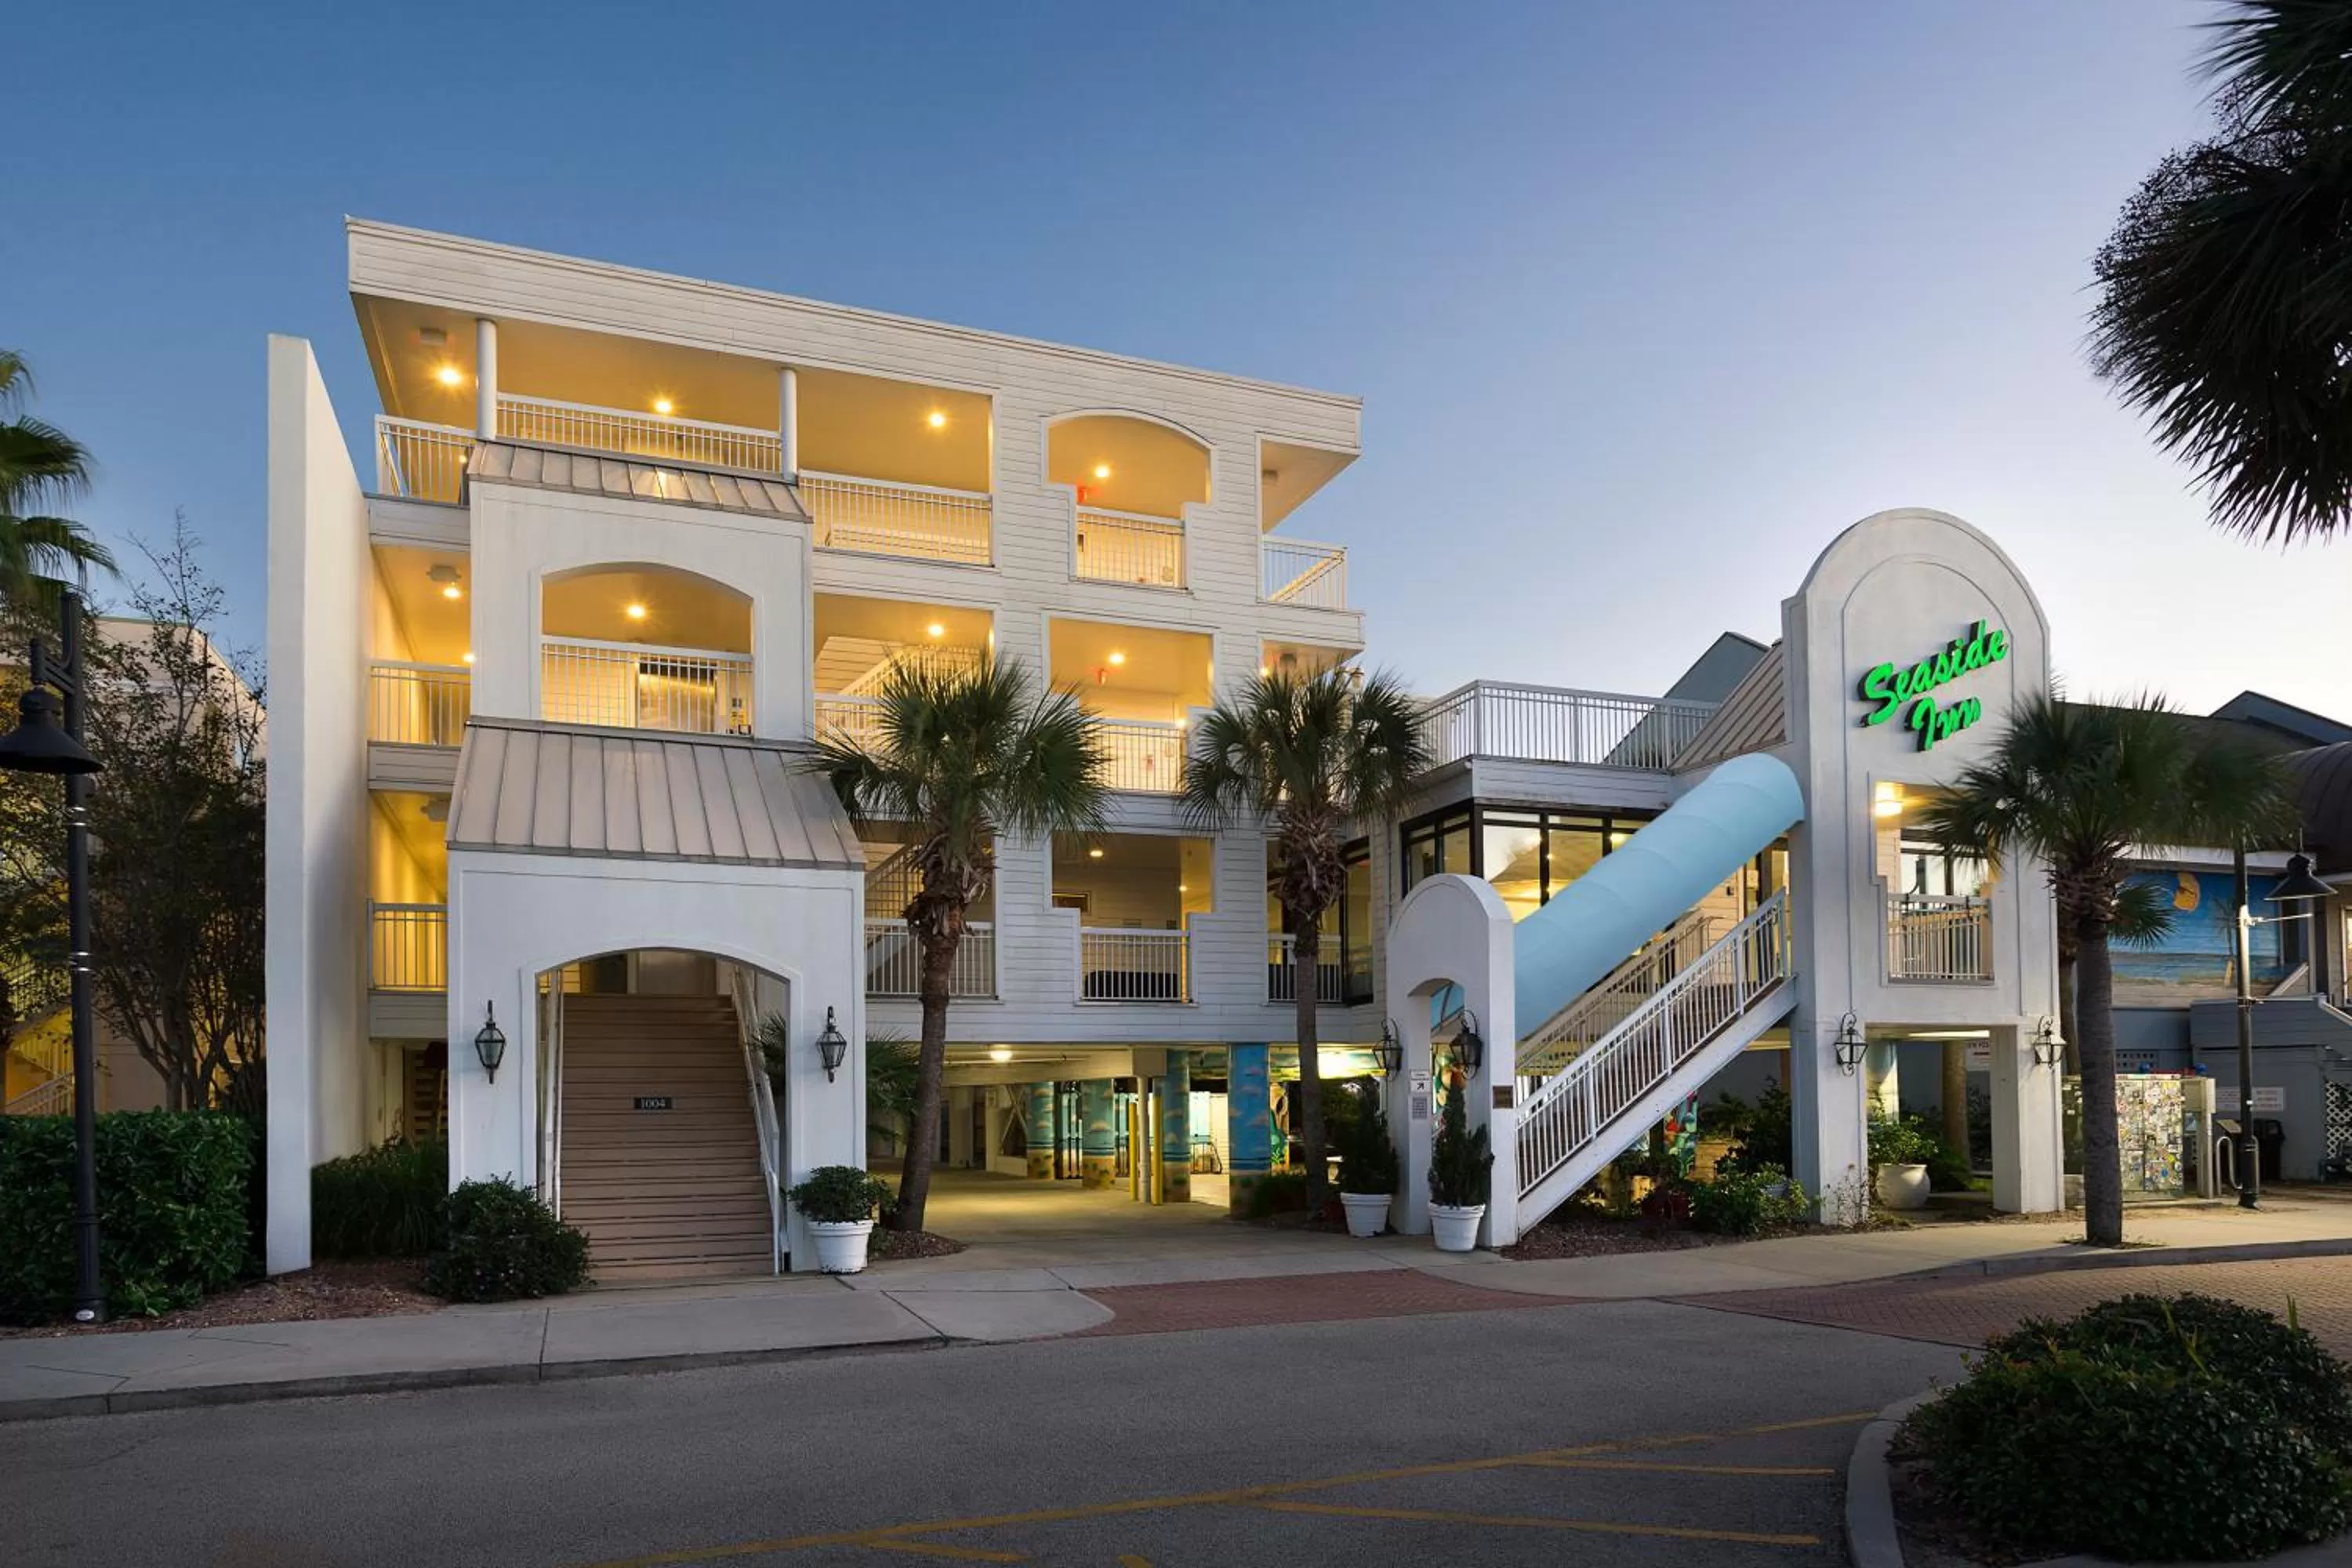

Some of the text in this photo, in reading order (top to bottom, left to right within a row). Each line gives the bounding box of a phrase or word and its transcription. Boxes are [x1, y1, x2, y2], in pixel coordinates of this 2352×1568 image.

[1859, 618, 2009, 726] Seaside
[1907, 695, 1982, 752] Inn
[641, 1098, 666, 1110] 1004
